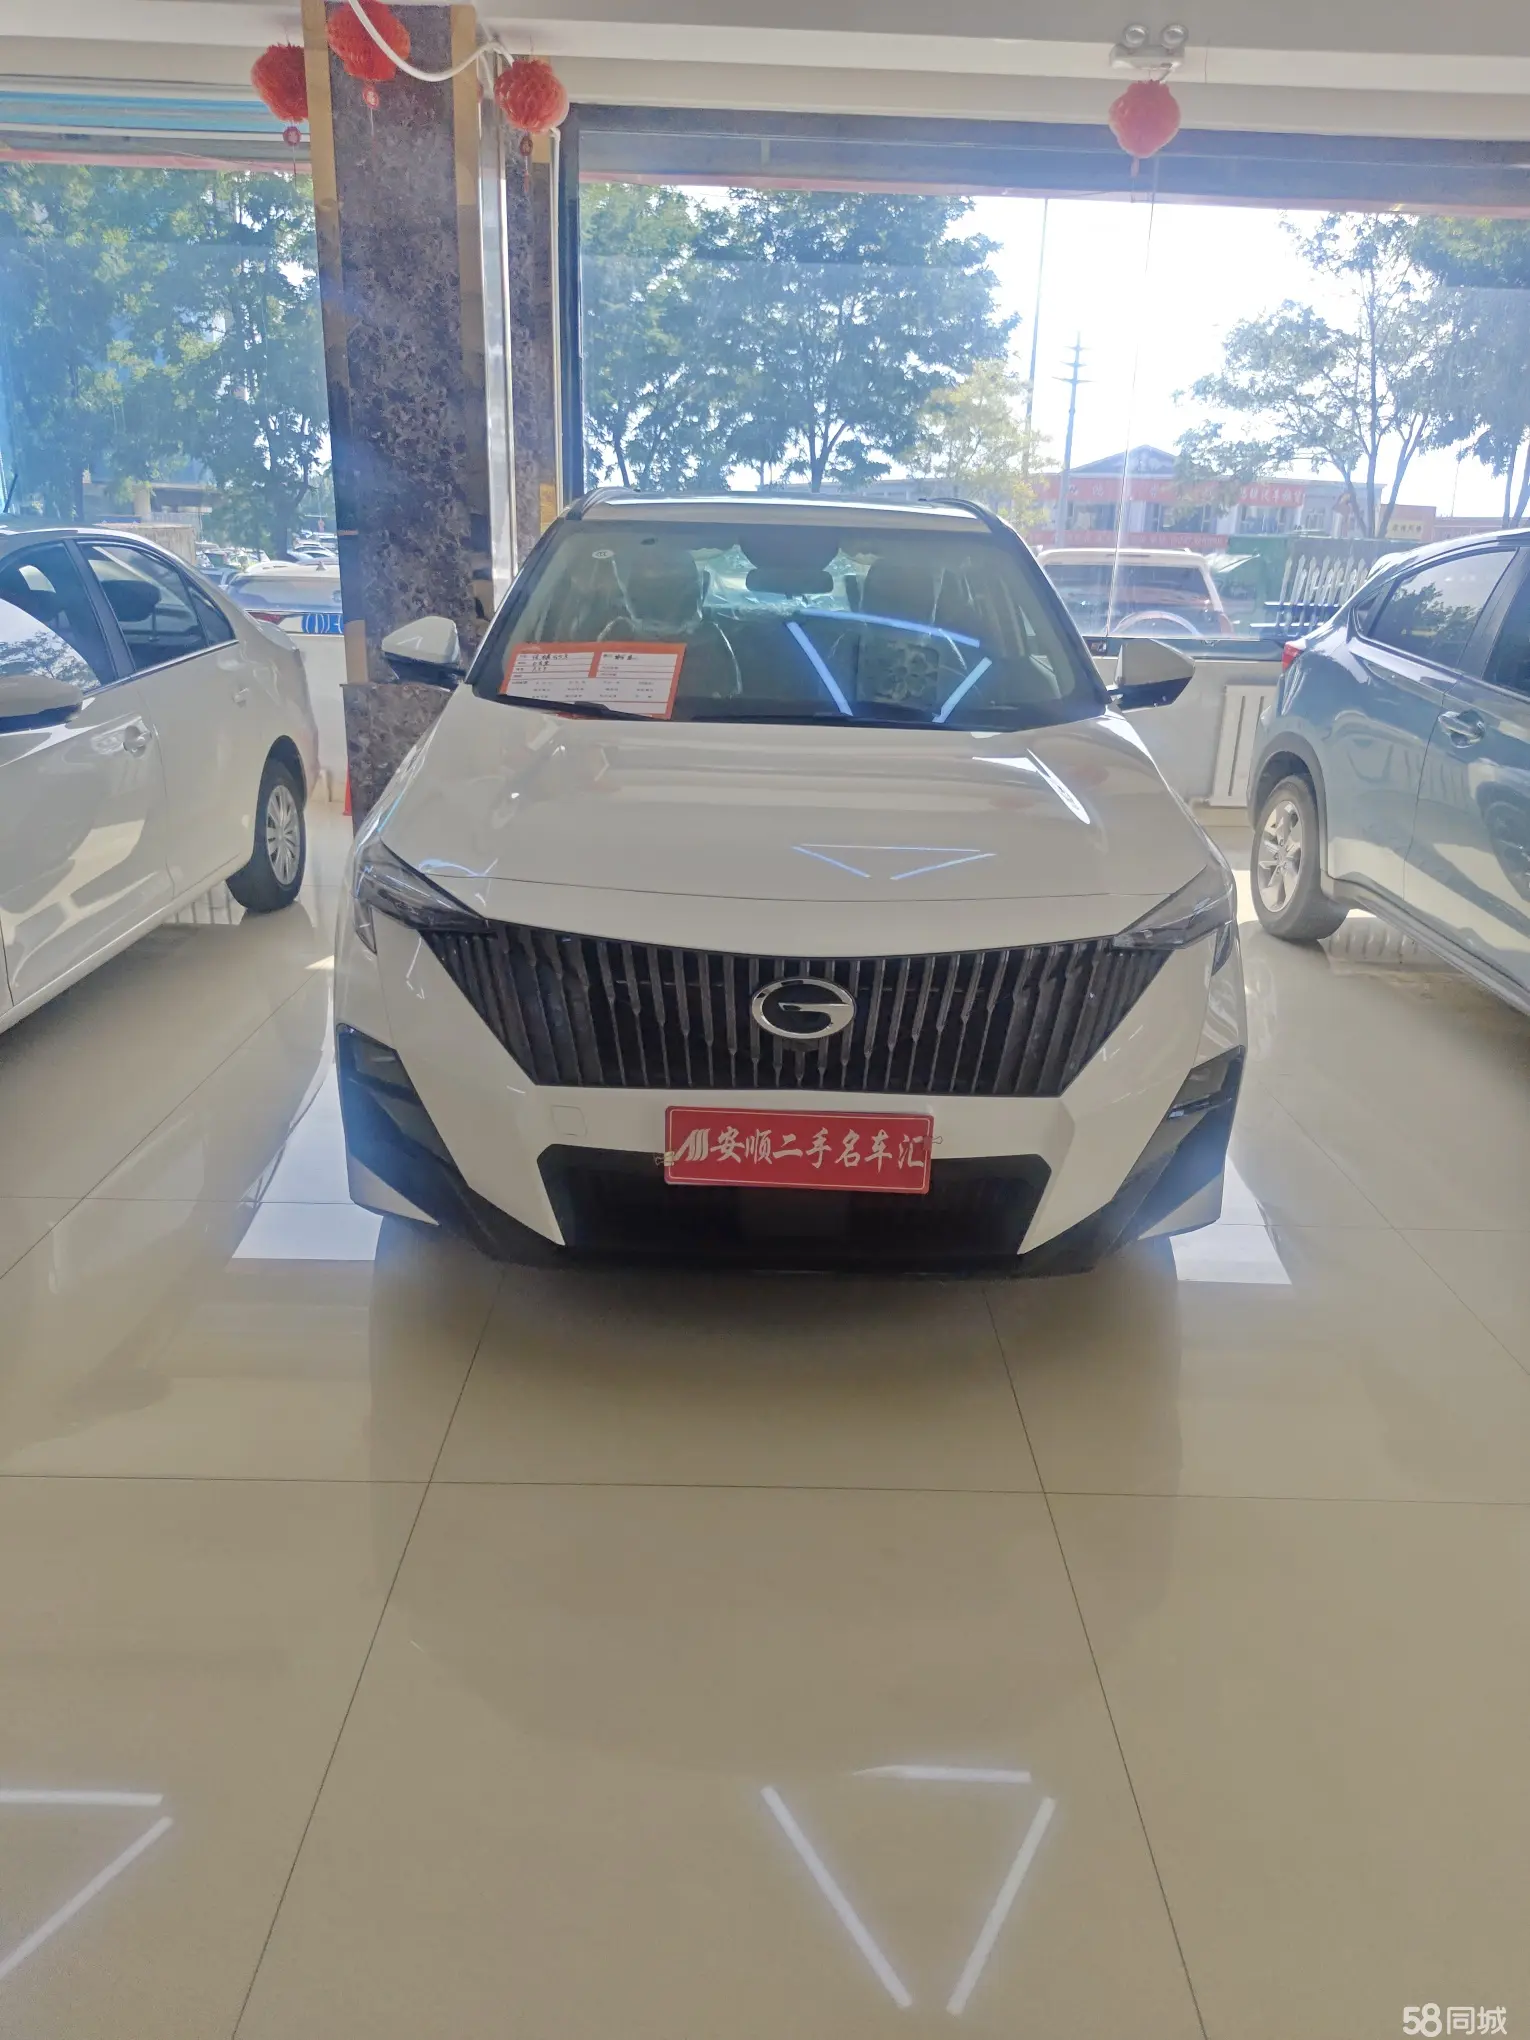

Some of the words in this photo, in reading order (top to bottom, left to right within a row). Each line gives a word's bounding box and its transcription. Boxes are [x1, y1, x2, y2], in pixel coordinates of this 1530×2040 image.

[710, 1126, 925, 1173] 安顺二手名车汇
